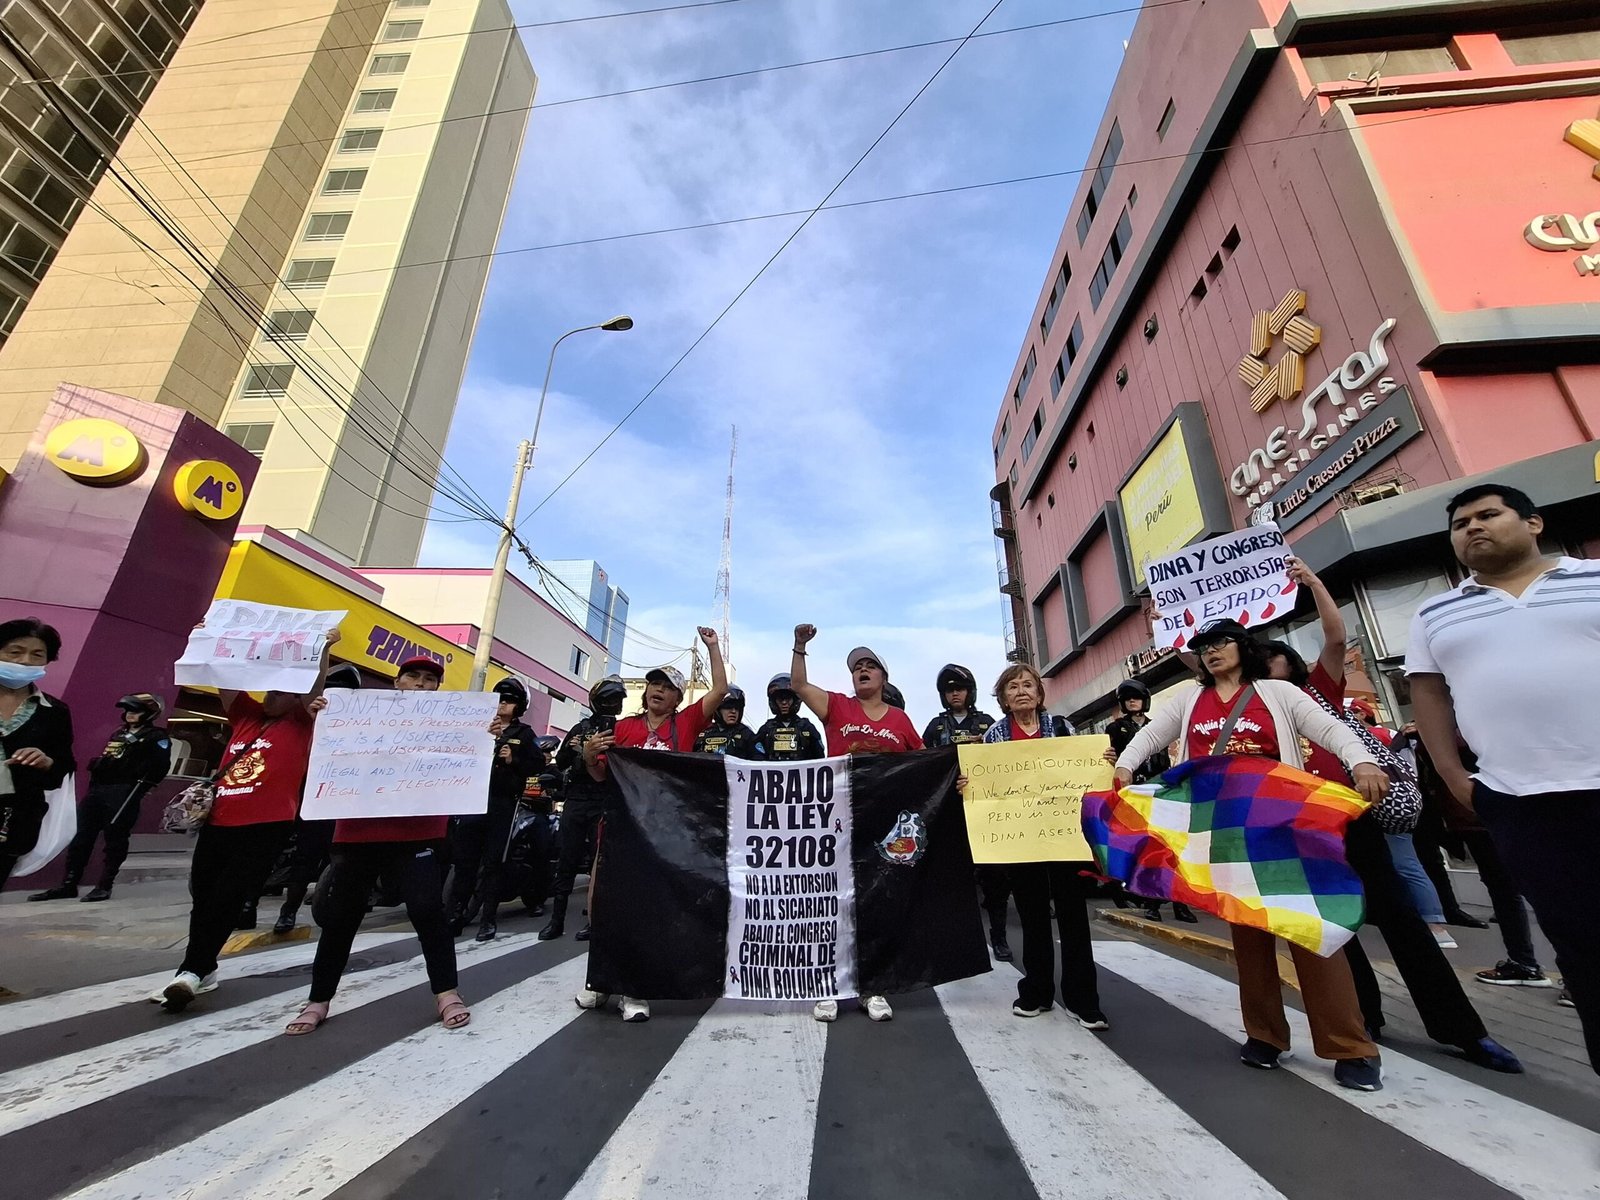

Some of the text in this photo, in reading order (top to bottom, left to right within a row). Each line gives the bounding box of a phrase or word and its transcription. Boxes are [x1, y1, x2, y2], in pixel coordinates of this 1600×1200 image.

[1276, 416, 1400, 518] Little Caesars Pizza
[1144, 490, 1172, 531] Perú
[1149, 556, 1193, 585] DINA
[1192, 549, 1206, 572] Y
[1212, 531, 1284, 564] CONGRESO
[1156, 553, 1293, 608] SON TERRORISTAS
[1203, 583, 1281, 619] ESTADO
[1137, 647, 1158, 668] Little
[412, 699, 443, 716] NOT
[379, 719, 396, 727] NO
[401, 719, 414, 727] ES
[317, 735, 344, 747] SHE
[374, 736, 383, 745] A
[370, 767, 396, 776] AND
[747, 765, 834, 804] ABAJO
[983, 781, 1000, 799] We
[1003, 784, 1032, 797] don't
[1065, 795, 1083, 806] YA
[746, 802, 835, 830] LA LEY
[988, 808, 1078, 824] PERU is OUR
[1037, 826, 1082, 839] ASESI
[745, 834, 837, 869] 32108
[745, 871, 838, 896] NO A LA EXTORSION
[745, 895, 839, 921] NO AL SICARIATO
[742, 919, 838, 944] ABAJO EL CONGRESO
[738, 941, 837, 968] CRIMINAL DE
[740, 965, 839, 1000] DINA BOLUARTE
